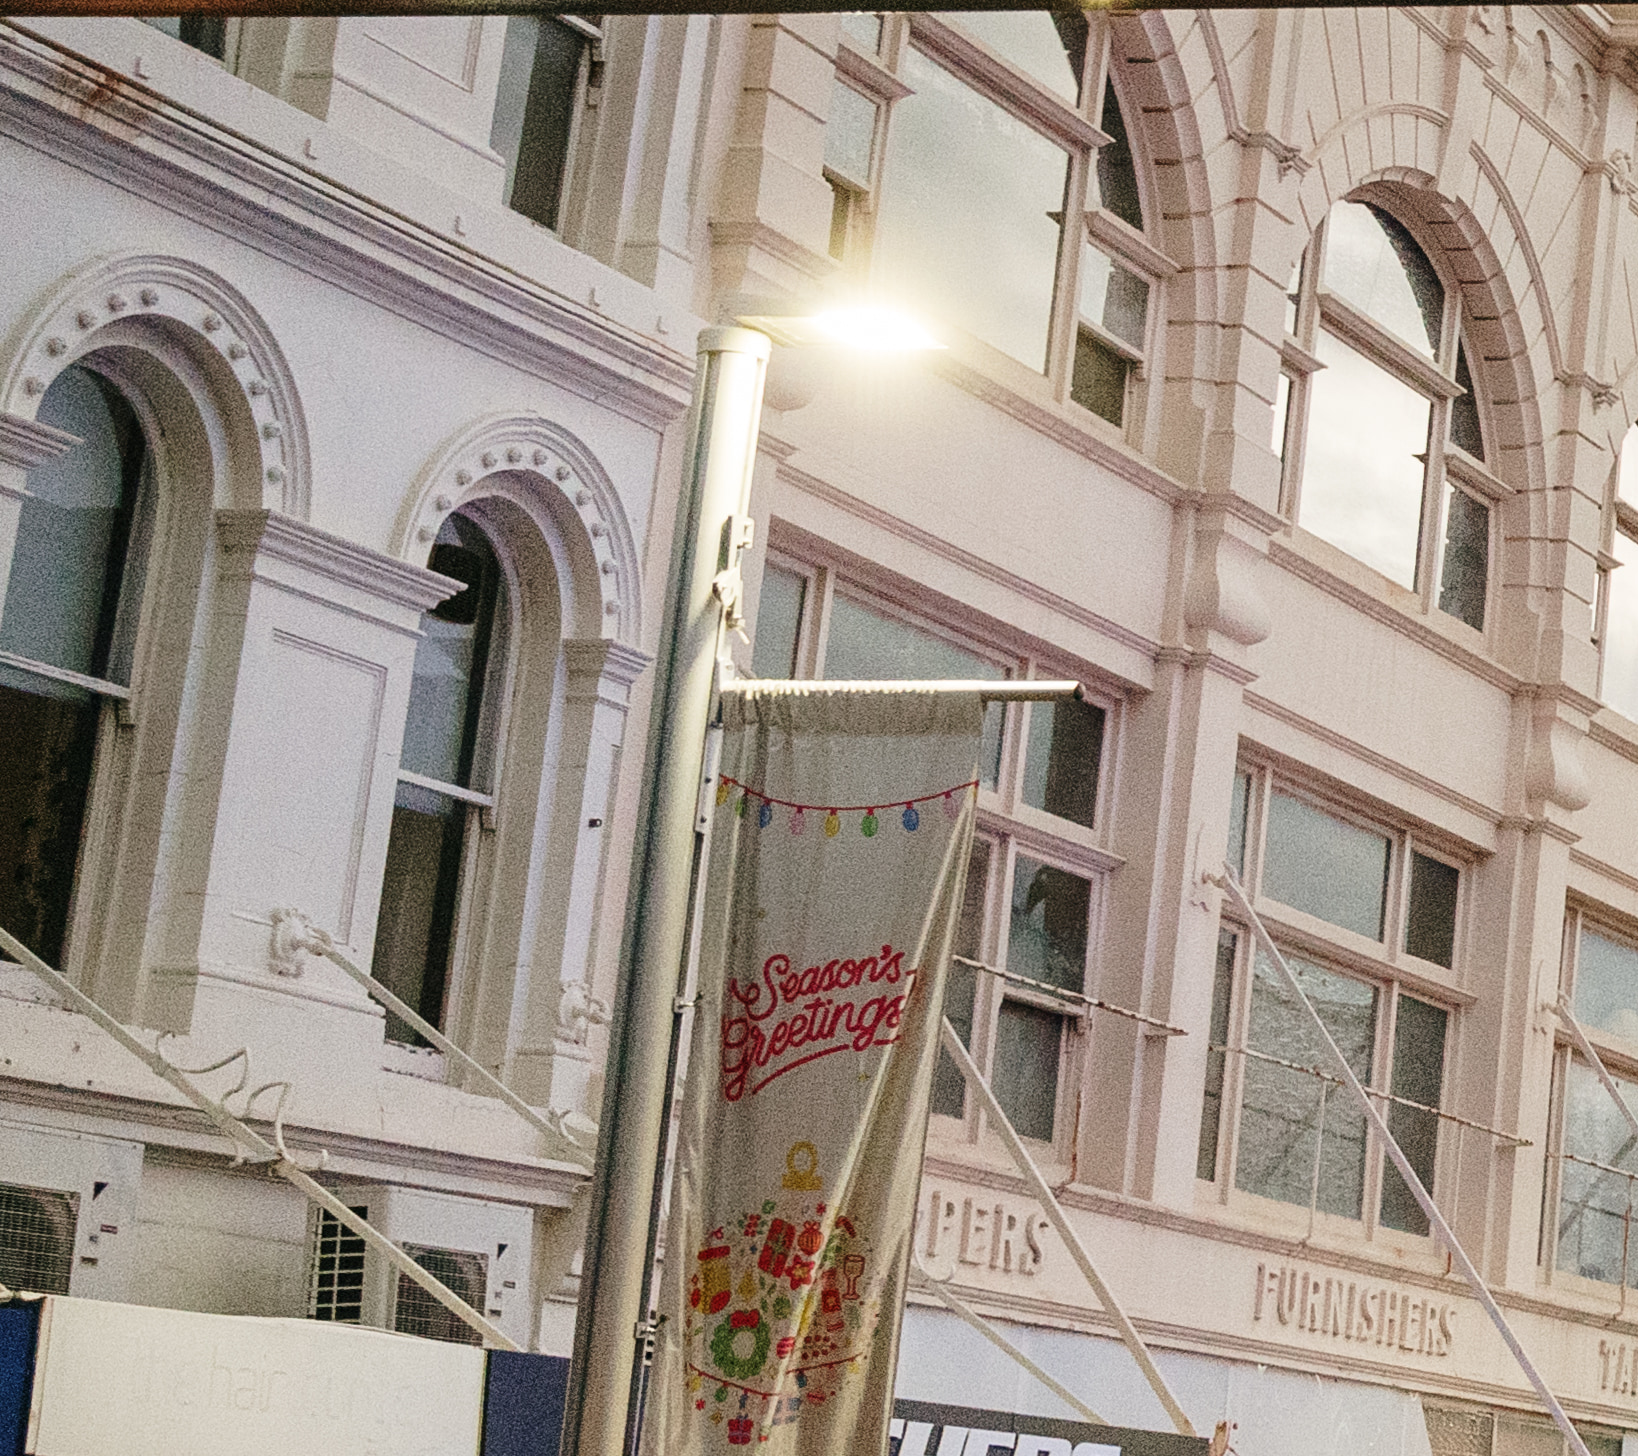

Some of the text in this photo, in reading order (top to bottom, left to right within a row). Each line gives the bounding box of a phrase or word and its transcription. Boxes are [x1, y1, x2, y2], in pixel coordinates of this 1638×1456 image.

[729, 944, 905, 1022] Season's
[721, 995, 906, 1102] Greetings
[917, 1191, 1050, 1277] PERS
[1253, 1263, 1458, 1357] FURNISHERS
